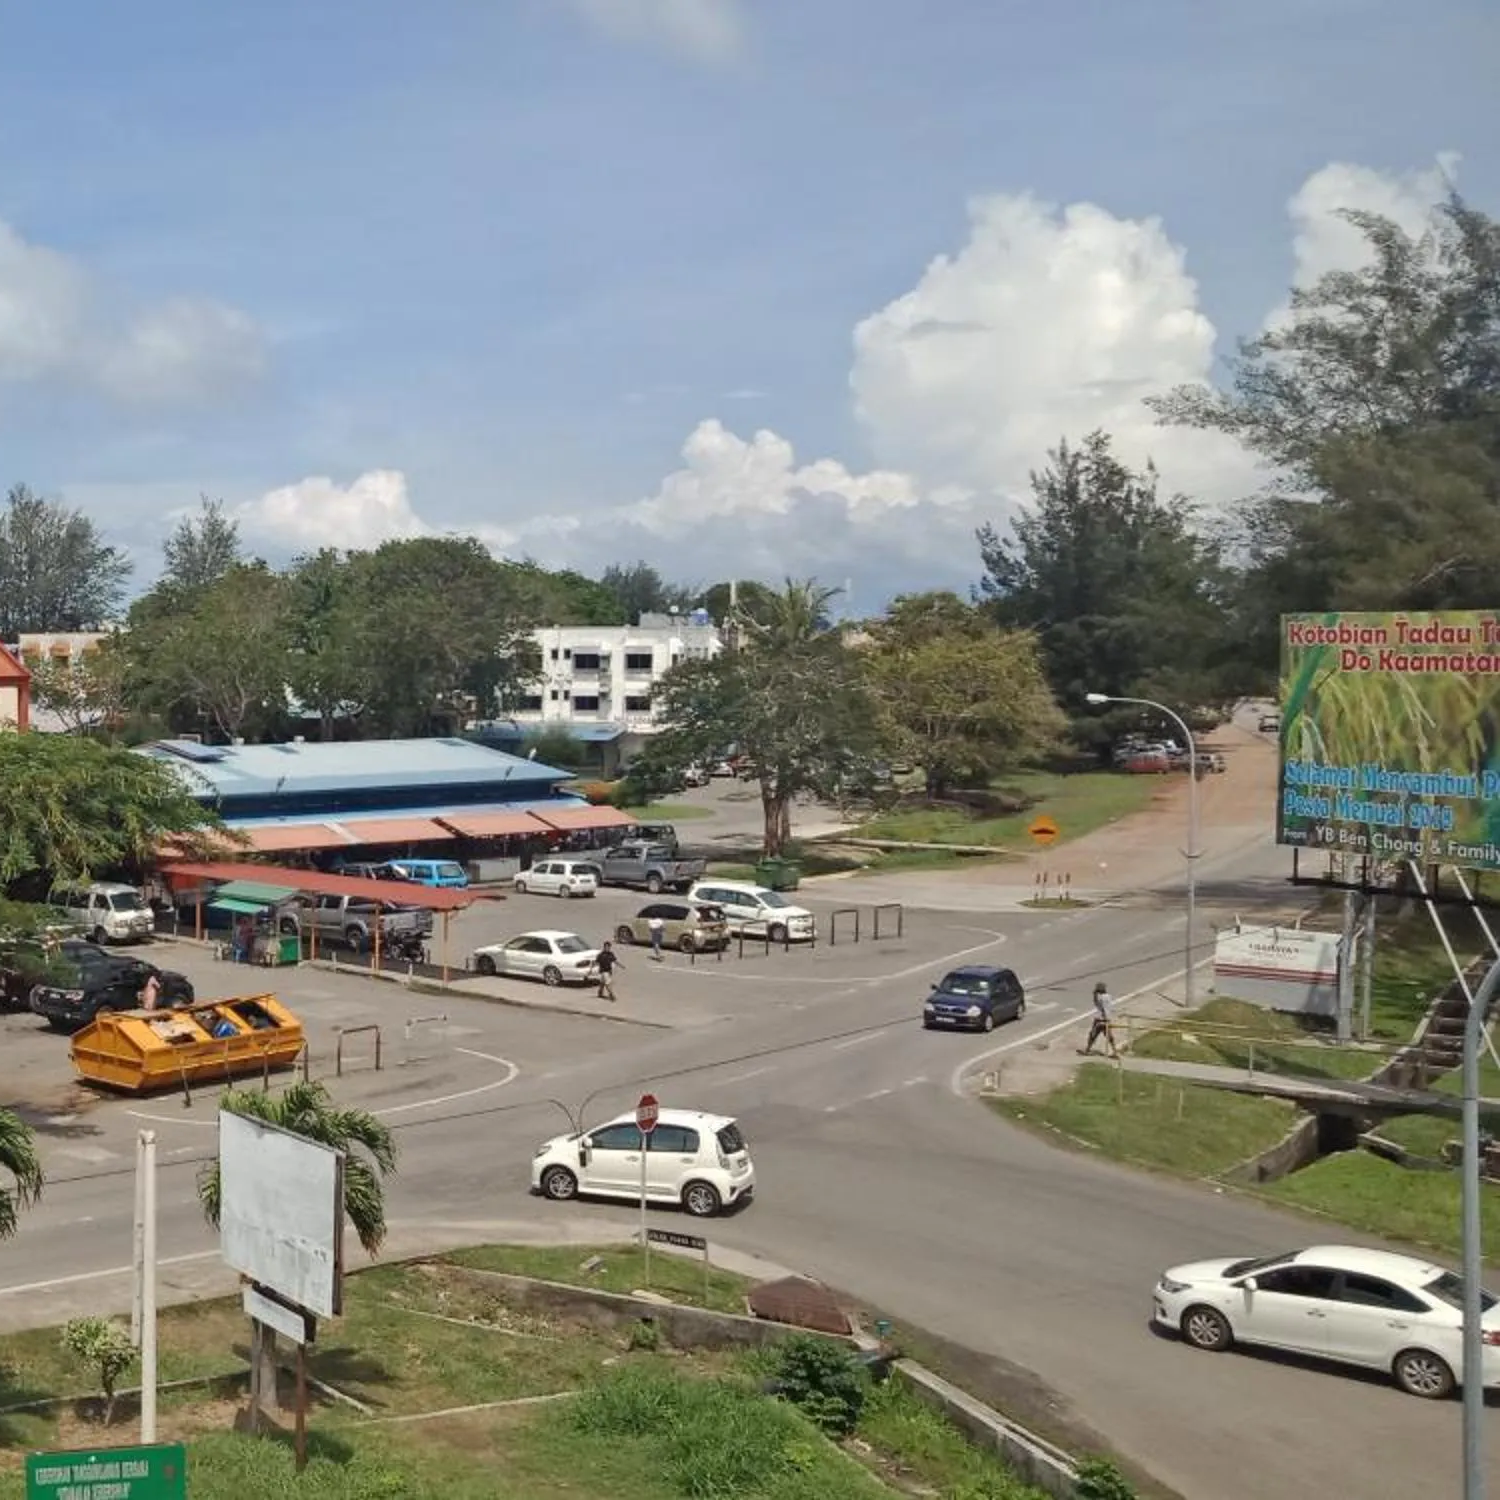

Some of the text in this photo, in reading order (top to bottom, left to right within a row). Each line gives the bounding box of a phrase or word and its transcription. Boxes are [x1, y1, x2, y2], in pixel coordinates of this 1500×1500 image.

[1288, 622, 1387, 645] Kotobian
[1396, 621, 1471, 645] Tadau
[1342, 650, 1371, 671] Do
[1483, 770, 1500, 799] P
[1316, 826, 1333, 842] YB
[1339, 828, 1367, 847] Ben
[1371, 833, 1423, 855] Chong
